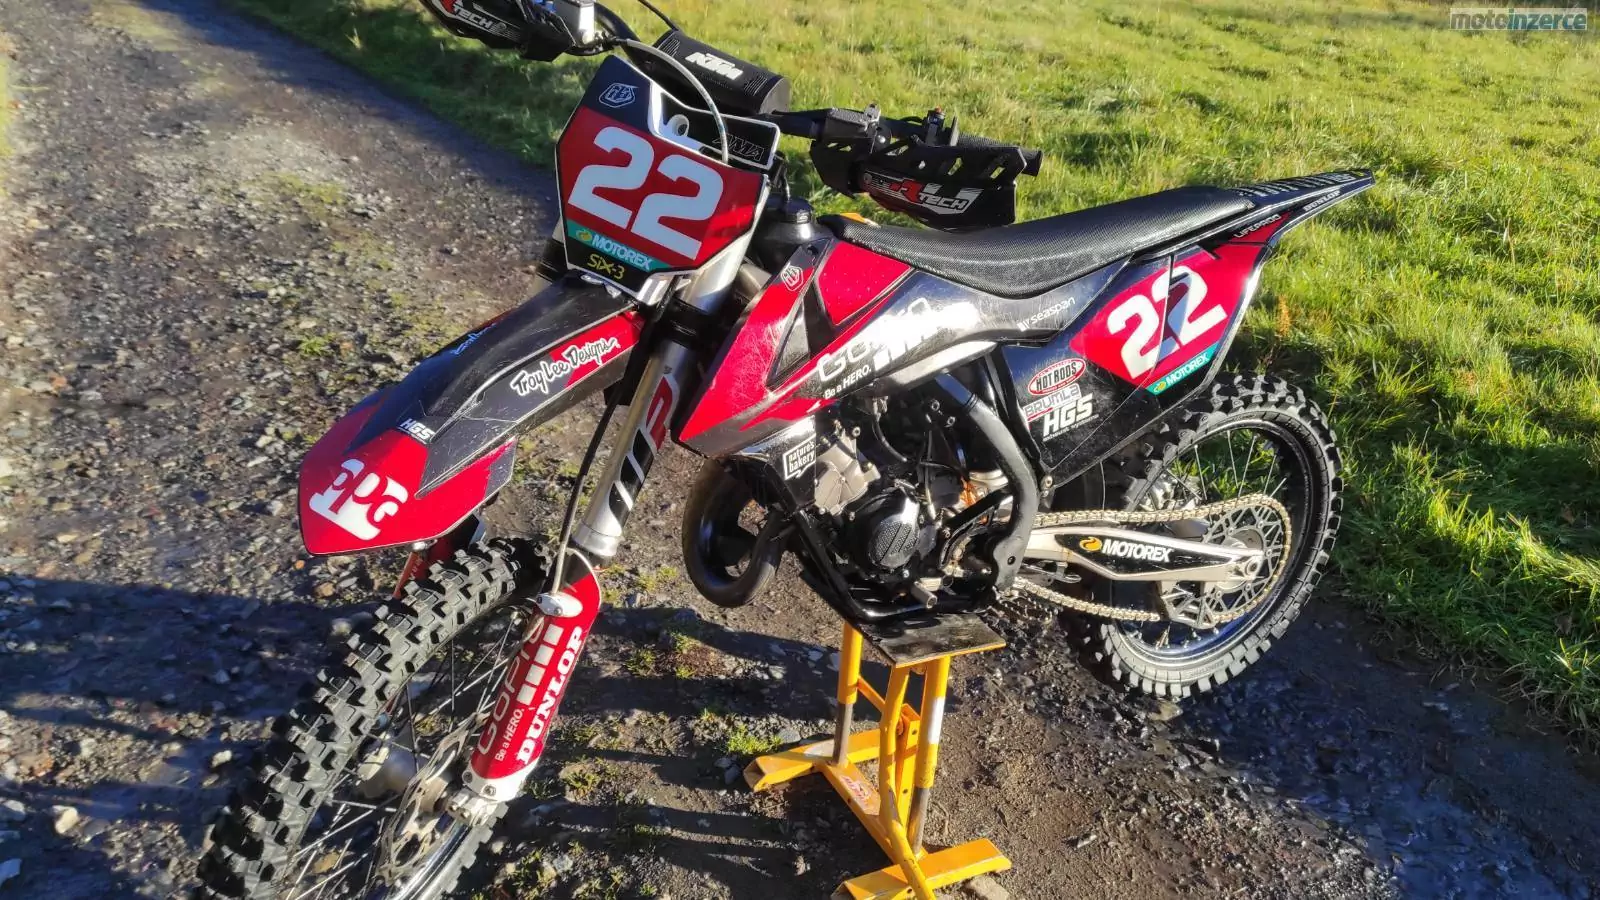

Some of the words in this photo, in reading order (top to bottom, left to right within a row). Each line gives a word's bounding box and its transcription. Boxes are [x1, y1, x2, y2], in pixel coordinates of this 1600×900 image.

[685, 52, 743, 80] KTM
[568, 126, 724, 260] 22
[1302, 190, 1341, 212] DUNLOP
[592, 234, 653, 272] MOTOREX
[1029, 297, 1076, 325] seaspan
[1107, 265, 1228, 379] 22
[510, 370, 548, 396] Troy
[540, 360, 570, 382] Lee
[562, 337, 618, 367] Designs
[824, 387, 836, 400] Be
[842, 364, 872, 388] HERO.
[1036, 372, 1053, 391] HOT
[1054, 361, 1077, 384] RODS
[1165, 352, 1211, 386] MOTOREX
[400, 418, 436, 440] HGS
[1043, 392, 1093, 437] HGS
[788, 440, 815, 462] nature's
[789, 450, 815, 472] bakery
[1101, 538, 1171, 562] MOTOREX
[516, 626, 583, 765] DUNLOP
[494, 747, 506, 763] Be
[505, 708, 525, 746] HERO.
